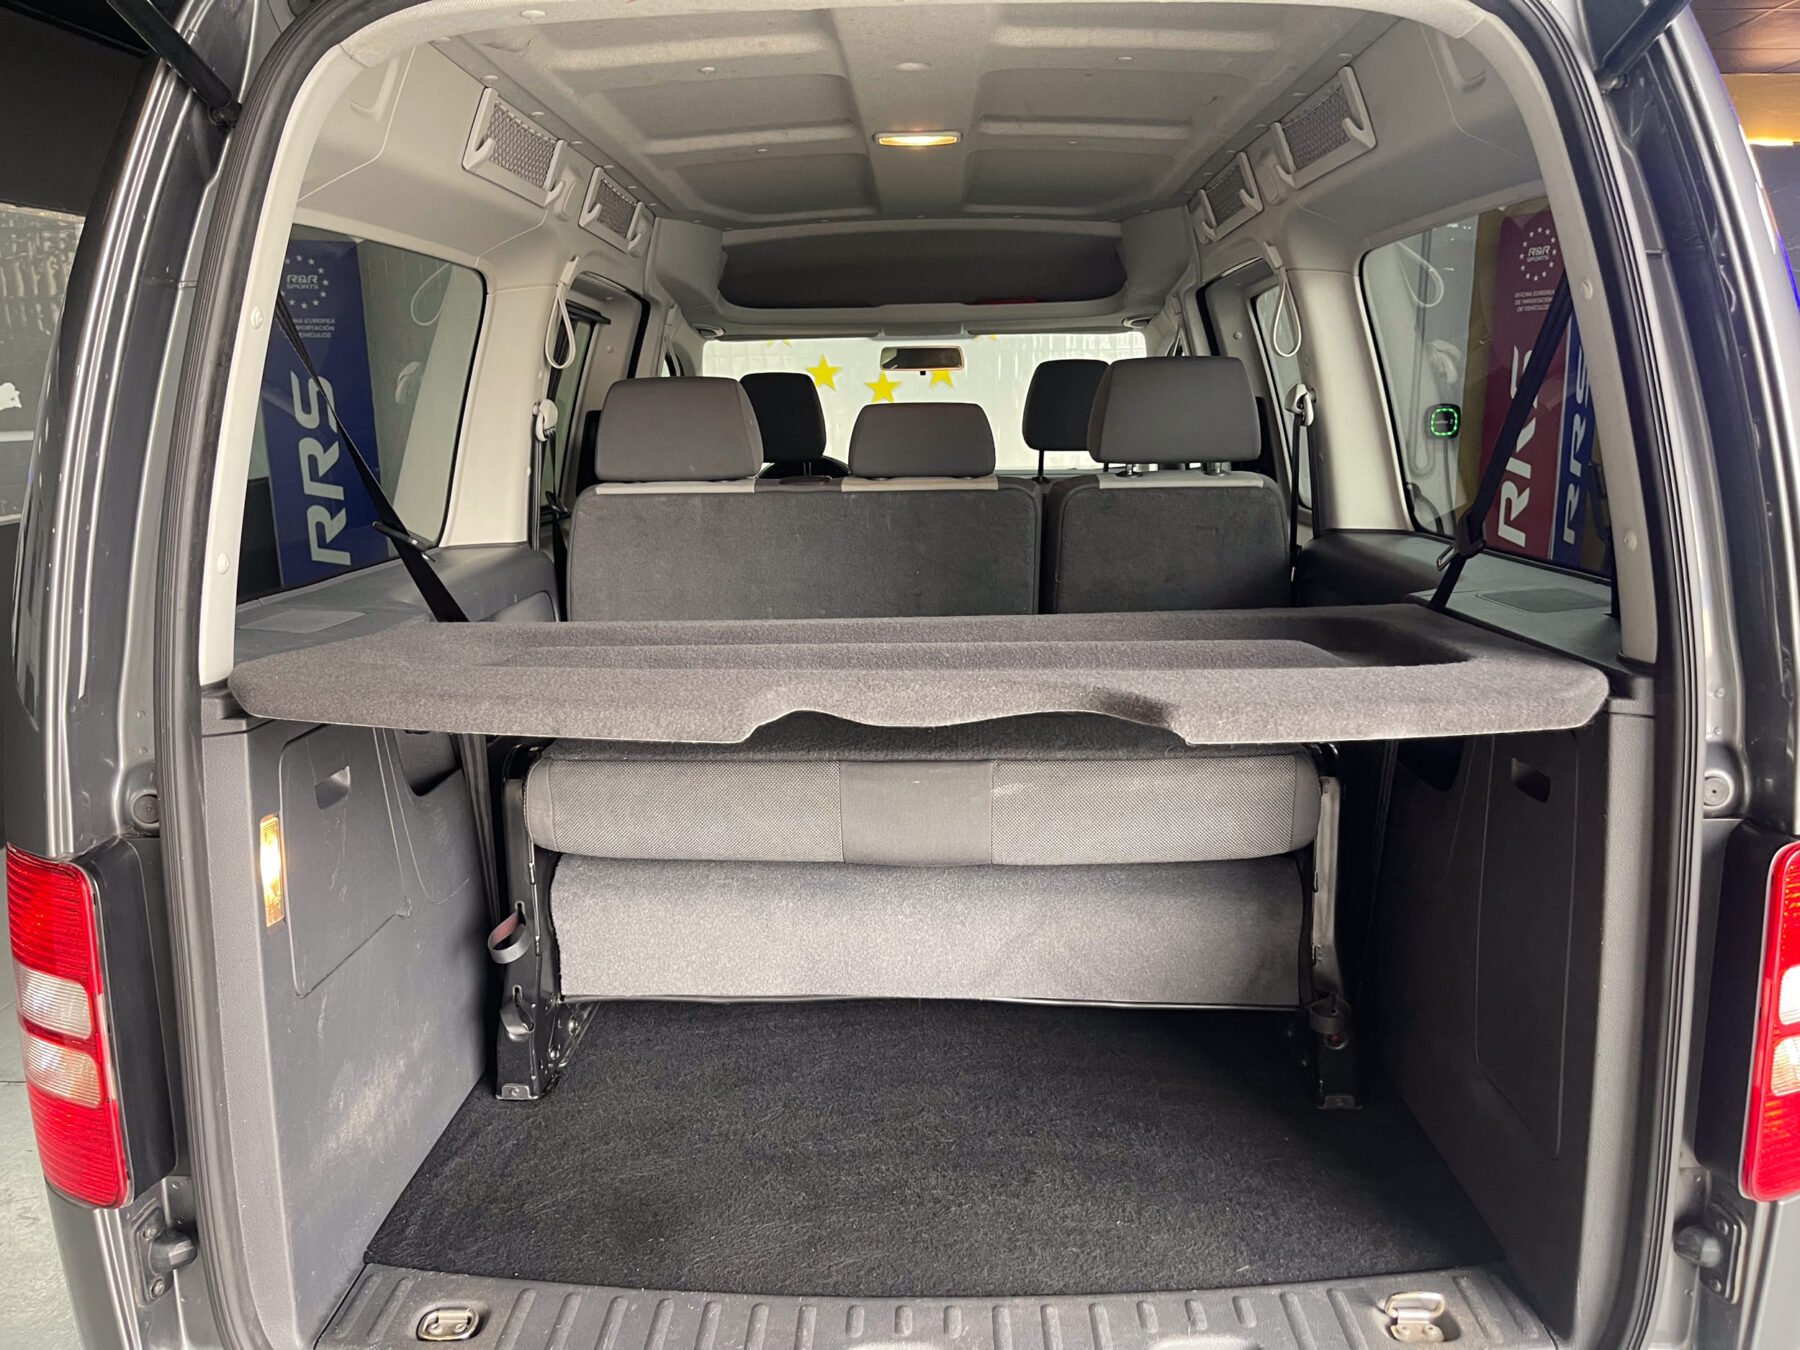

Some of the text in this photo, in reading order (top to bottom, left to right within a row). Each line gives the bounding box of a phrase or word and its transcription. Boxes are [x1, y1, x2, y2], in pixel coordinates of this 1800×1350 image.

[1528, 245, 1551, 257] R&R
[286, 274, 318, 284] R&R
[290, 370, 352, 566] RRS
